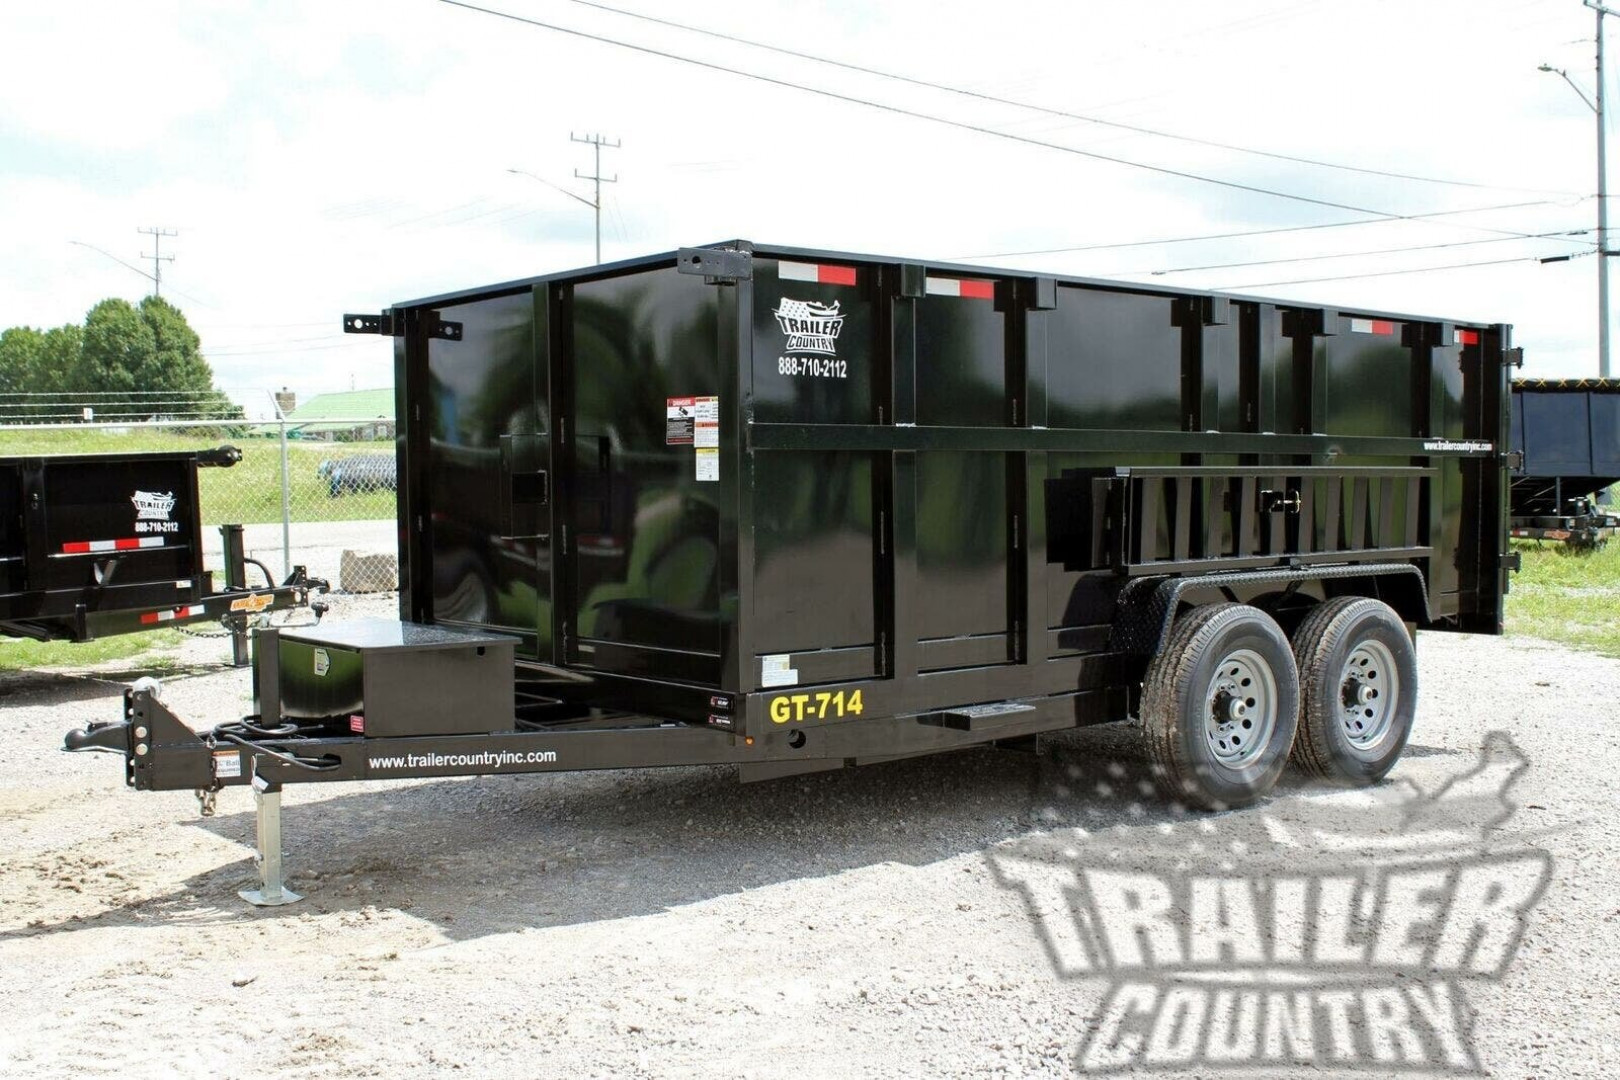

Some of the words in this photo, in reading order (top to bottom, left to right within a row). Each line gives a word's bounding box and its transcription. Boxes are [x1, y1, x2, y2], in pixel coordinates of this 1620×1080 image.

[775, 314, 843, 338] TRAILER
[787, 335, 835, 352] COUNTRY
[778, 356, 847, 378] 888-710-2112
[1424, 441, 1492, 453] www.trailercountryinc.com
[770, 689, 863, 723] GT-714
[369, 750, 557, 769] www.trailercountryinc.com
